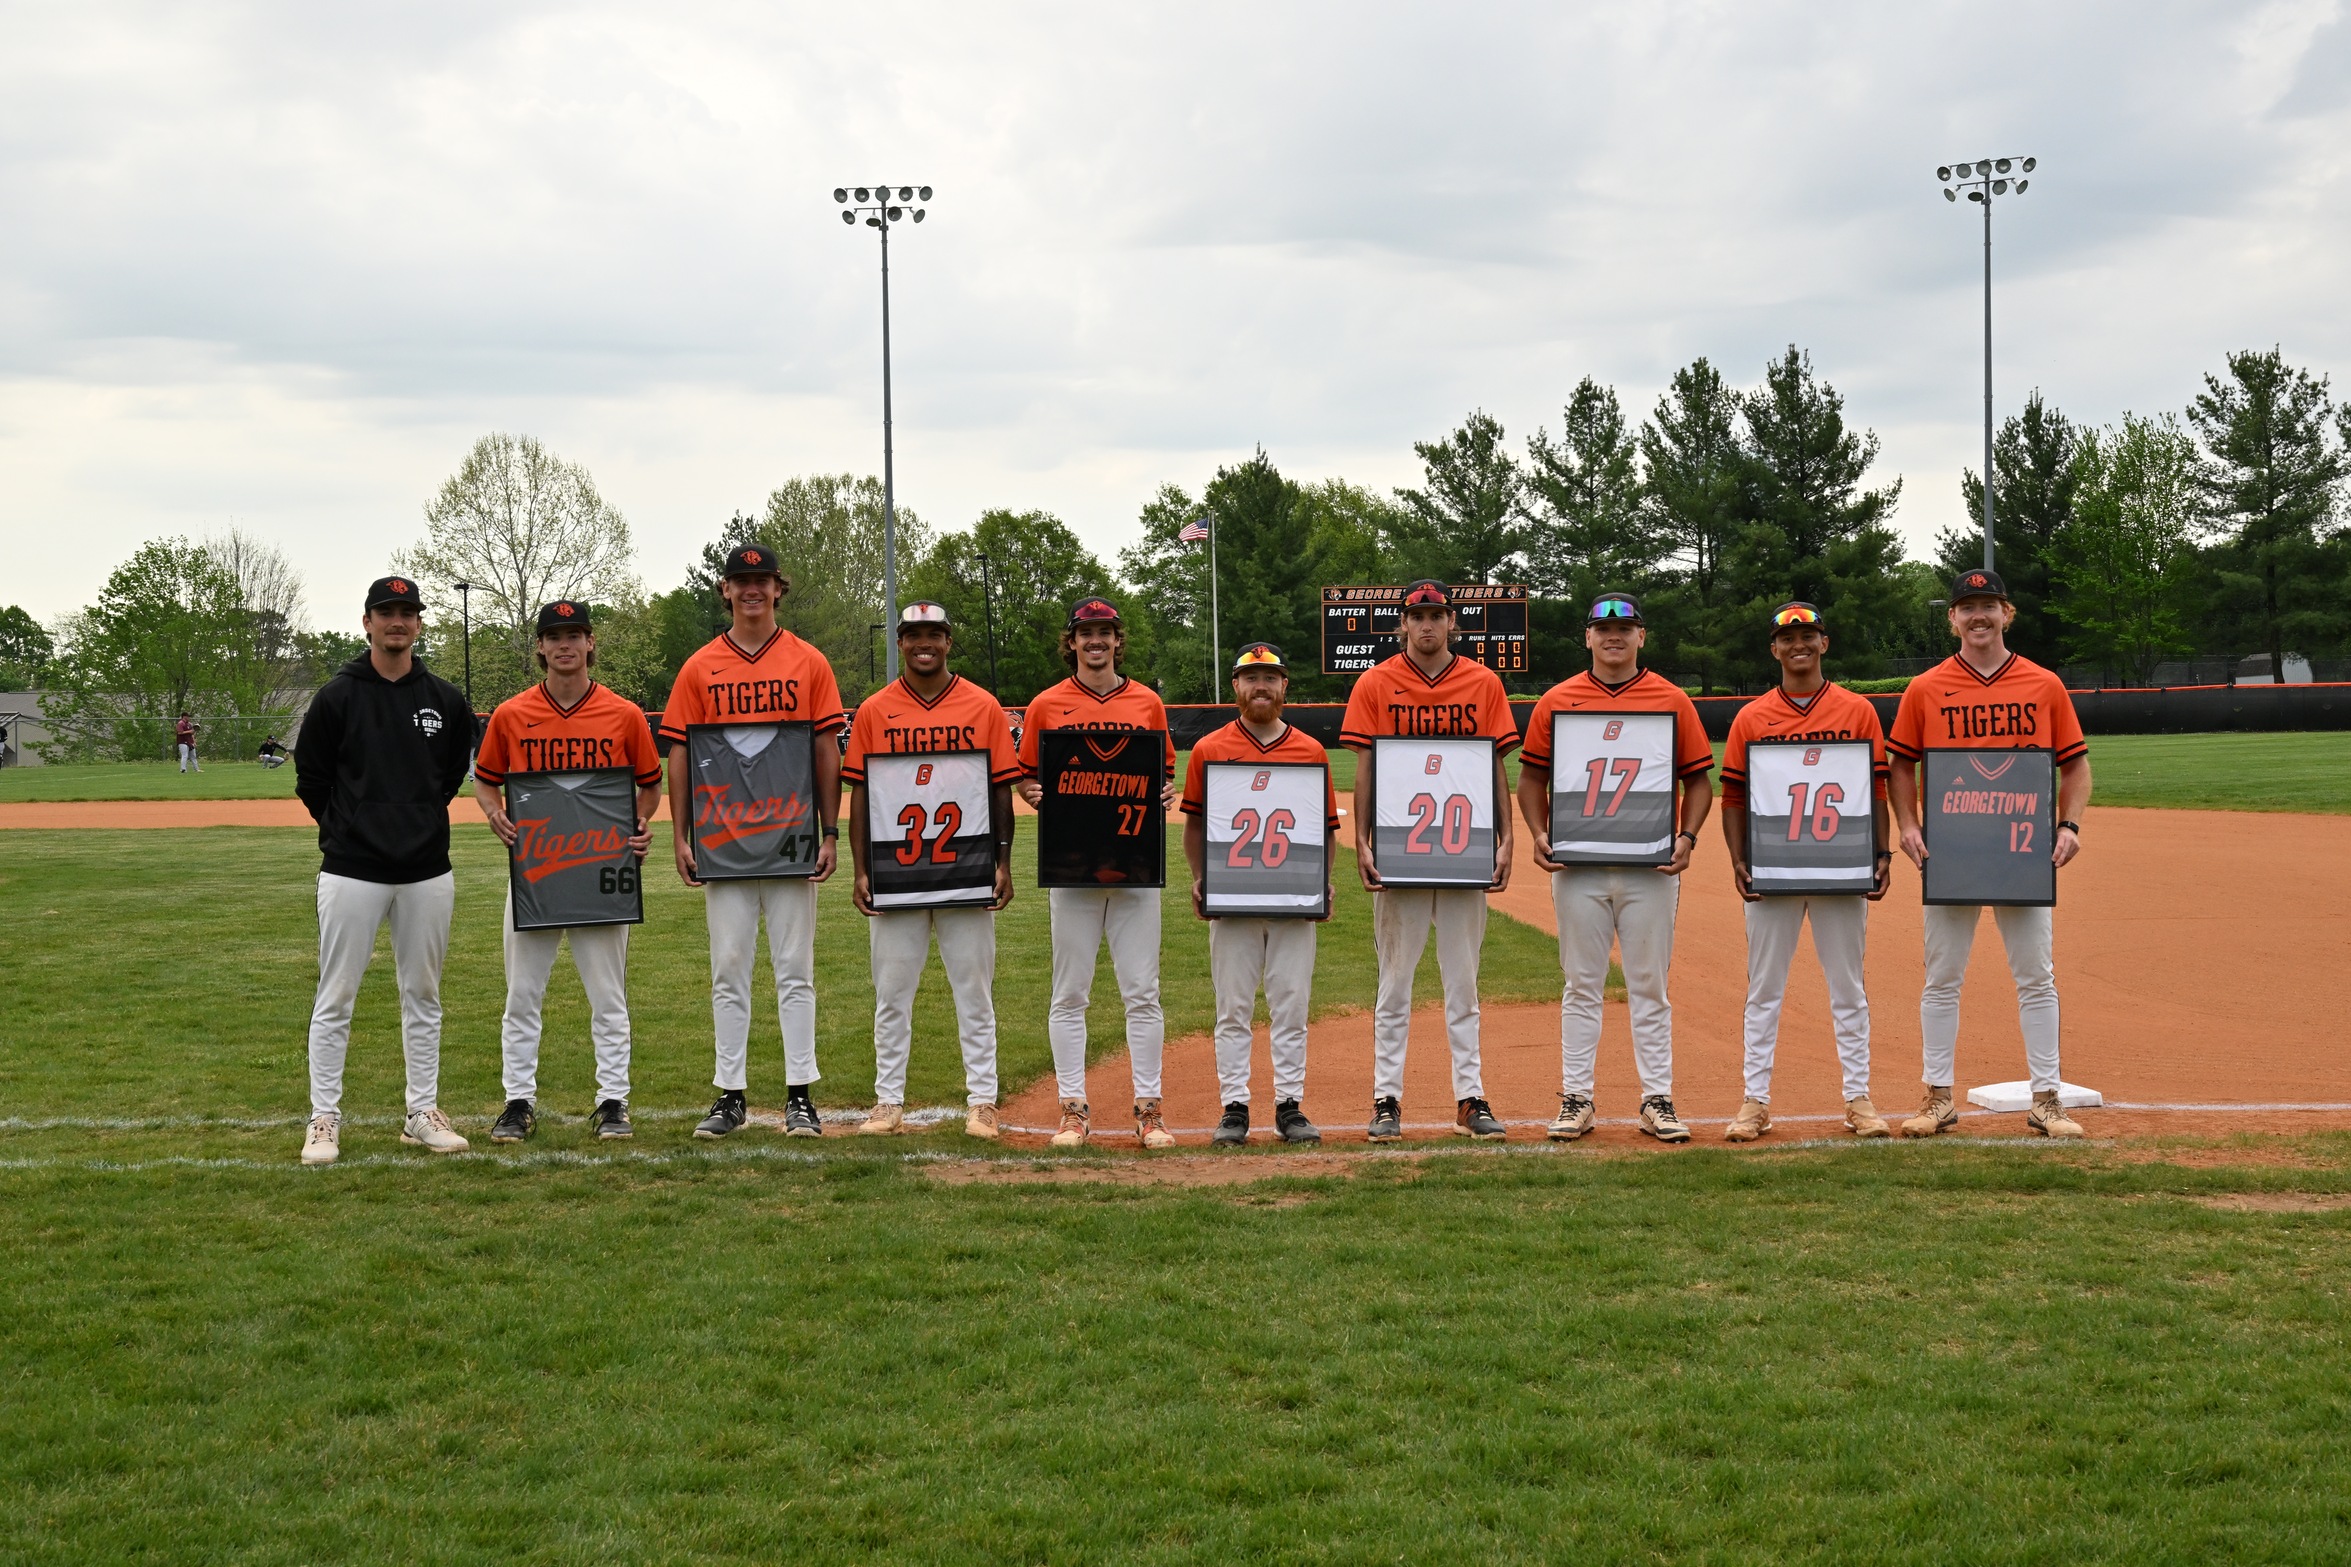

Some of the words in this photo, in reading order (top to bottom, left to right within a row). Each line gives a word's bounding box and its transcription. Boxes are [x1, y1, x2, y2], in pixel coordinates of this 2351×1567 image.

[1345, 588, 1406, 600] GEORGE
[1451, 587, 1504, 599] TIGERS
[1328, 608, 1366, 617] BATTER
[1374, 608, 1399, 616] BALL
[1462, 606, 1483, 615] OUT
[1347, 617, 1356, 631] 0
[1335, 644, 1375, 655] GUEST
[1477, 642, 1484, 654] 0
[1498, 642, 1506, 654] 0
[1498, 656, 1506, 668] 0
[1513, 656, 1521, 668] 0
[1334, 659, 1376, 669] TIGERS
[707, 679, 798, 717] TIGERS
[413, 719, 443, 729] TGERS
[1388, 703, 1478, 736] TIGERS
[1602, 720, 1624, 741] G
[1940, 702, 2037, 739] TIGERS
[884, 725, 975, 752] TIGERS
[520, 737, 613, 771] TIGERS
[1424, 754, 1442, 775] G
[1803, 747, 1822, 766] G
[915, 763, 933, 786] G
[1057, 770, 1150, 799] GEORGETOWN
[1251, 770, 1272, 791] G
[1581, 757, 1643, 818] 17
[694, 783, 808, 832] Tigers
[1786, 782, 1845, 842] 16
[1942, 790, 2038, 816] GEORGETOWN
[895, 801, 963, 867] 32
[1117, 803, 1148, 836] 27
[1404, 792, 1473, 855] 20
[514, 816, 628, 866] Tigers
[779, 834, 814, 863] 47
[1226, 807, 1296, 869] 26
[2009, 821, 2034, 853] 12
[599, 866, 635, 895] 66
